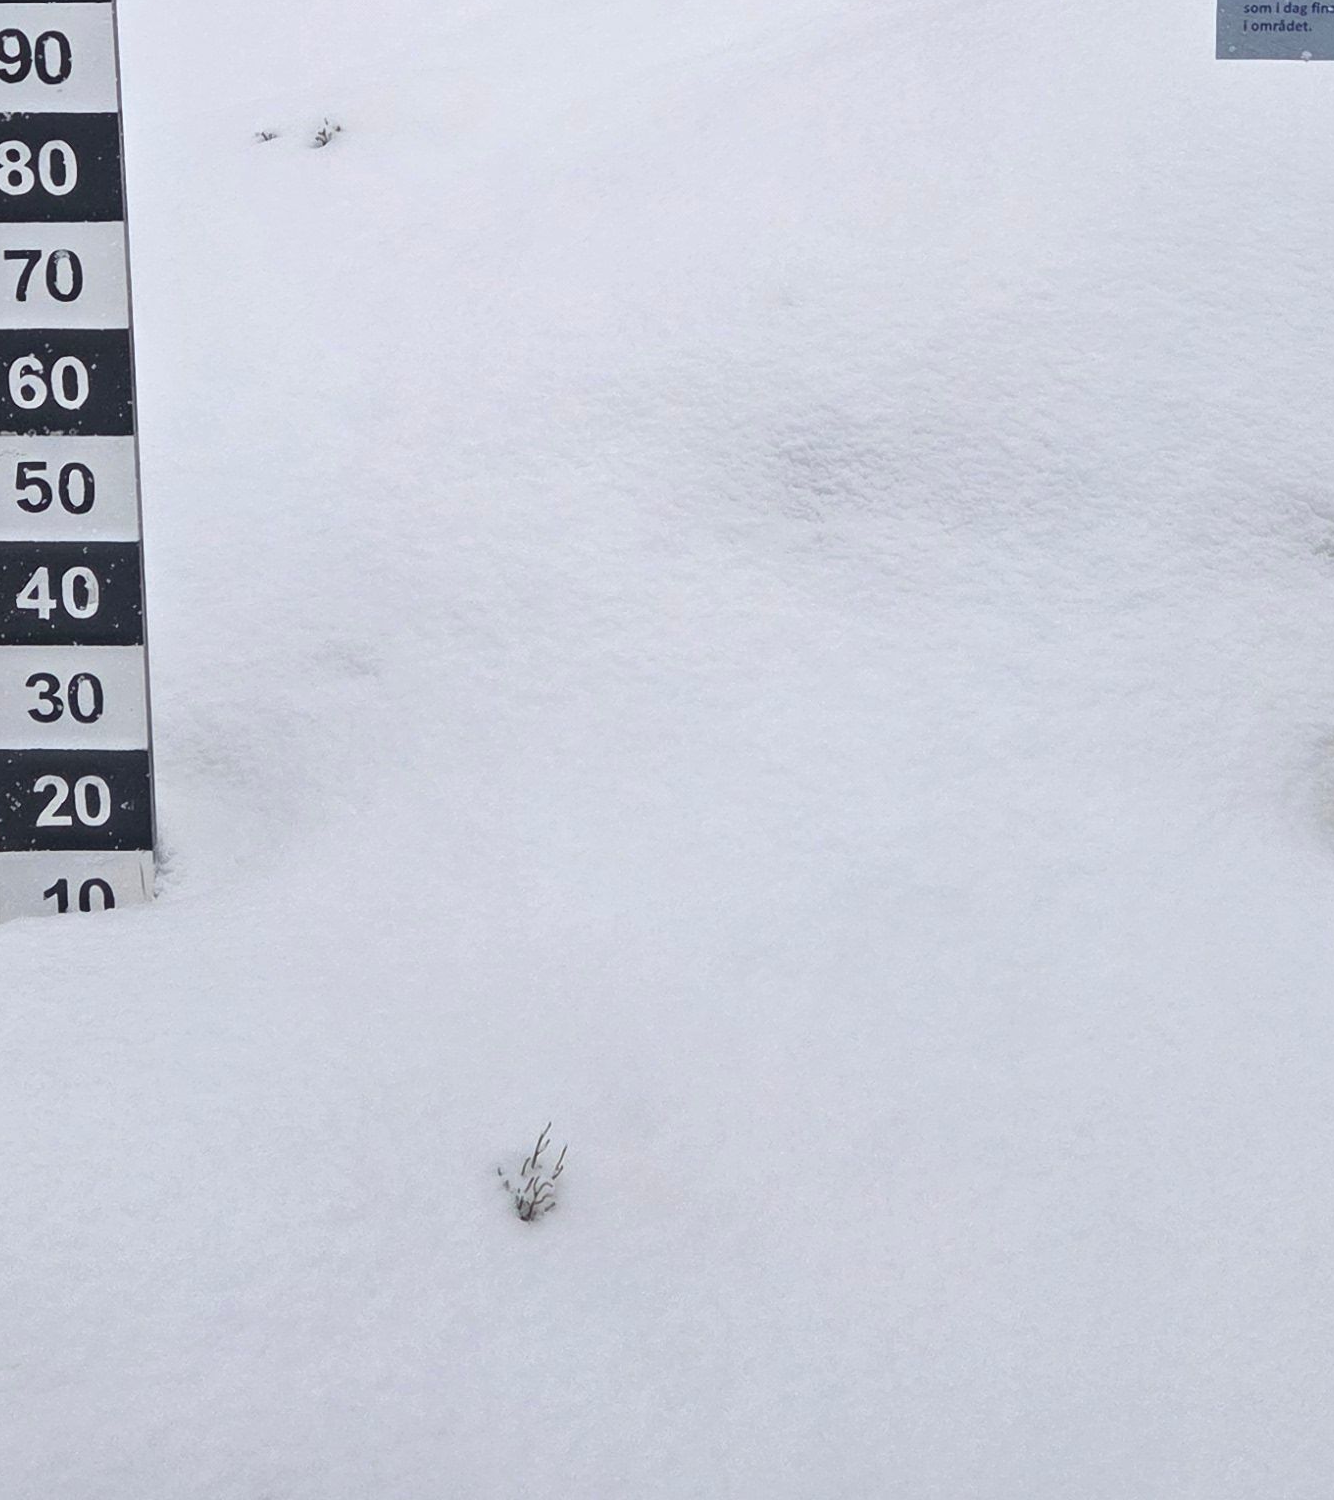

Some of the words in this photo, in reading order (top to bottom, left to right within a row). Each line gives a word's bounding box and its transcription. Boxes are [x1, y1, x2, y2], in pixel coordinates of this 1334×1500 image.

[1243, 20, 1247, 32] i
[1251, 19, 1312, 32] området.
[1244, 4, 1271, 14] som
[1276, 2, 1280, 14] i
[1283, 2, 1307, 16] dag
[4, 249, 83, 302] 70
[8, 355, 90, 409] 60
[15, 462, 95, 514] 50
[16, 567, 99, 619] 40
[25, 672, 104, 724] 30
[32, 775, 112, 827] 20
[44, 878, 115, 913] 10
